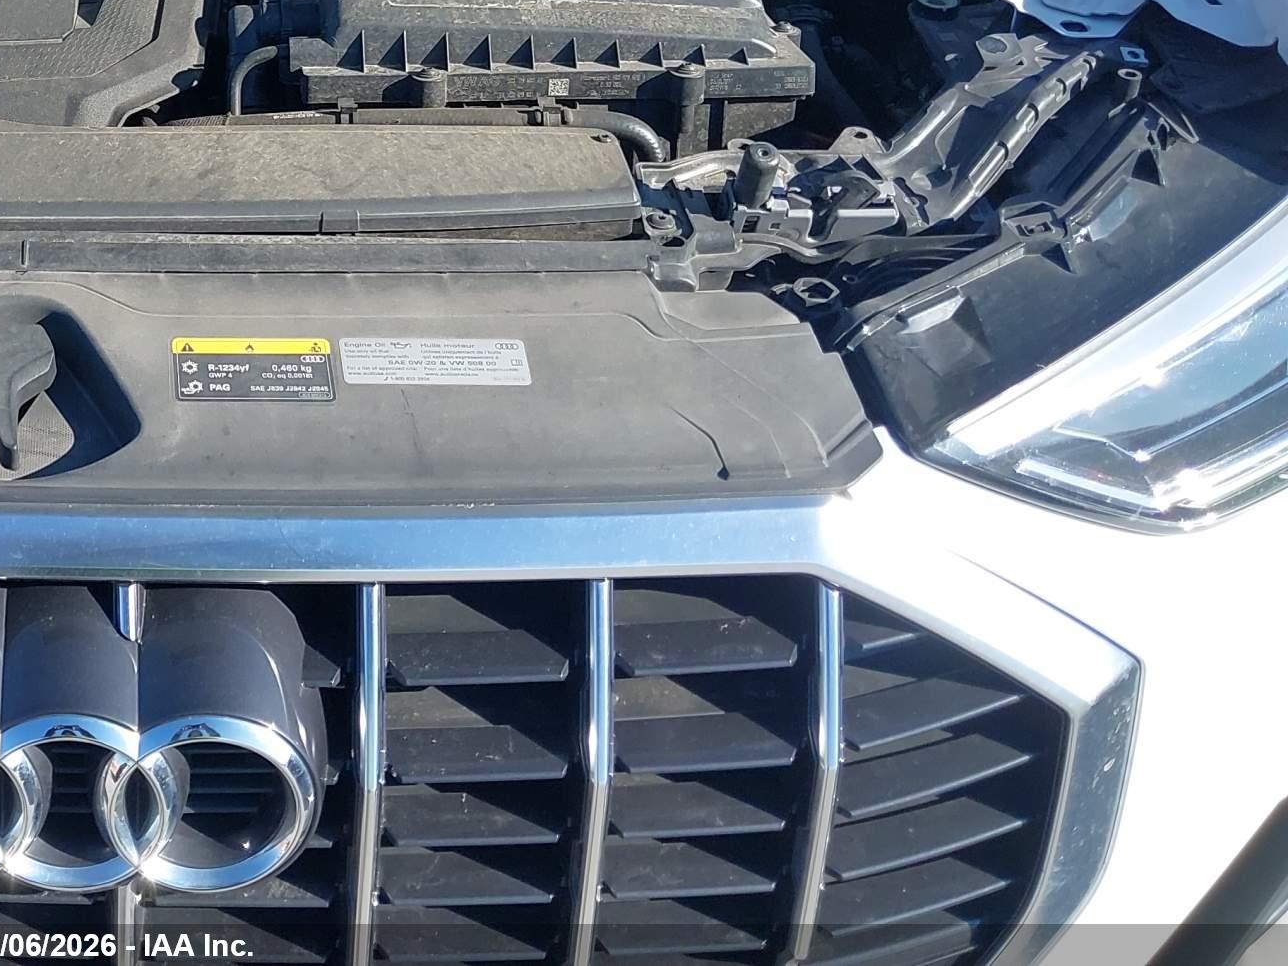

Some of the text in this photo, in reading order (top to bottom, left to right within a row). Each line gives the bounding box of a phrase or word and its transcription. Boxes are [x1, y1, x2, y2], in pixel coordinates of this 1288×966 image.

[343, 341, 372, 349] Engine
[207, 363, 250, 374] R-1234yf
[300, 364, 313, 374] kg
[209, 383, 232, 392] PAG
